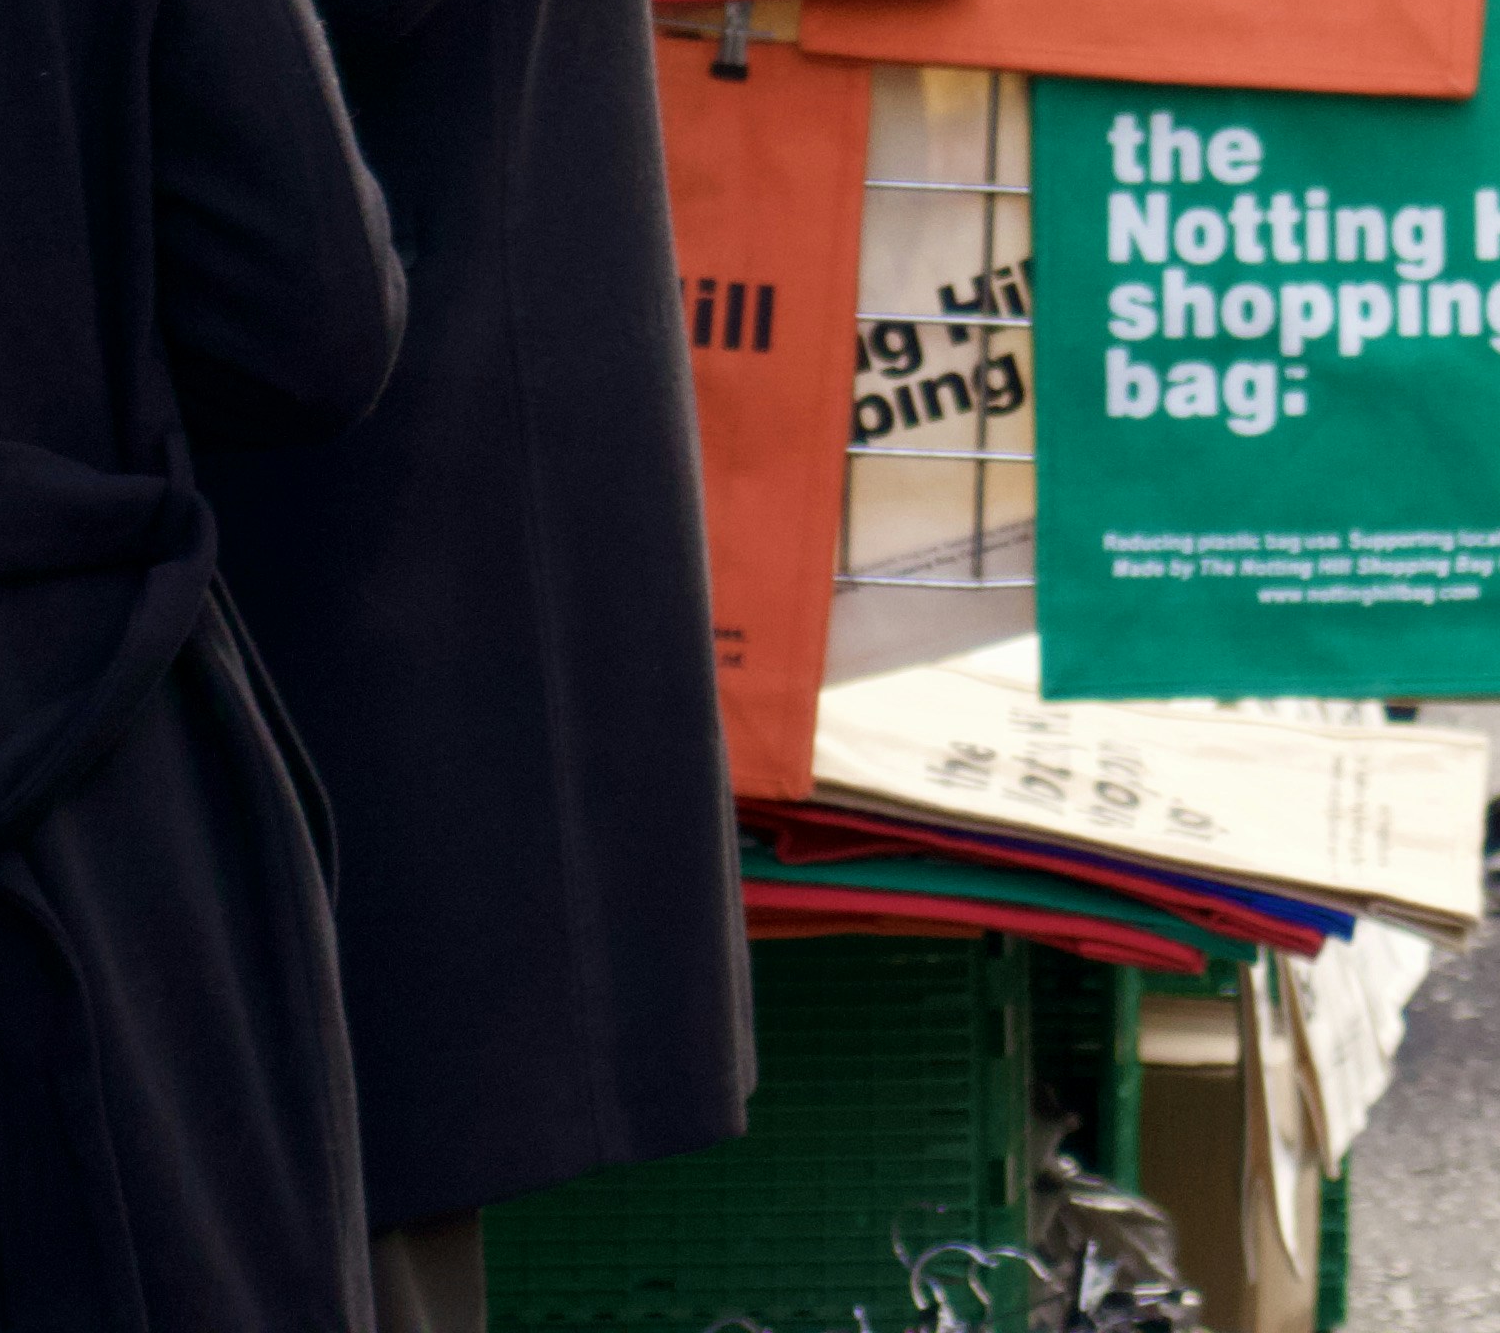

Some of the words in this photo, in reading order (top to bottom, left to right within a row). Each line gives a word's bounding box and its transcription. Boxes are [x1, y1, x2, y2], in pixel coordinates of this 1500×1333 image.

[1108, 112, 1263, 185] the
[1106, 187, 1446, 281] Notting
[688, 277, 776, 354] ill
[852, 353, 1026, 445] ping
[1348, 529, 1454, 554] Supporting
[1357, 555, 1450, 579] Shopping
